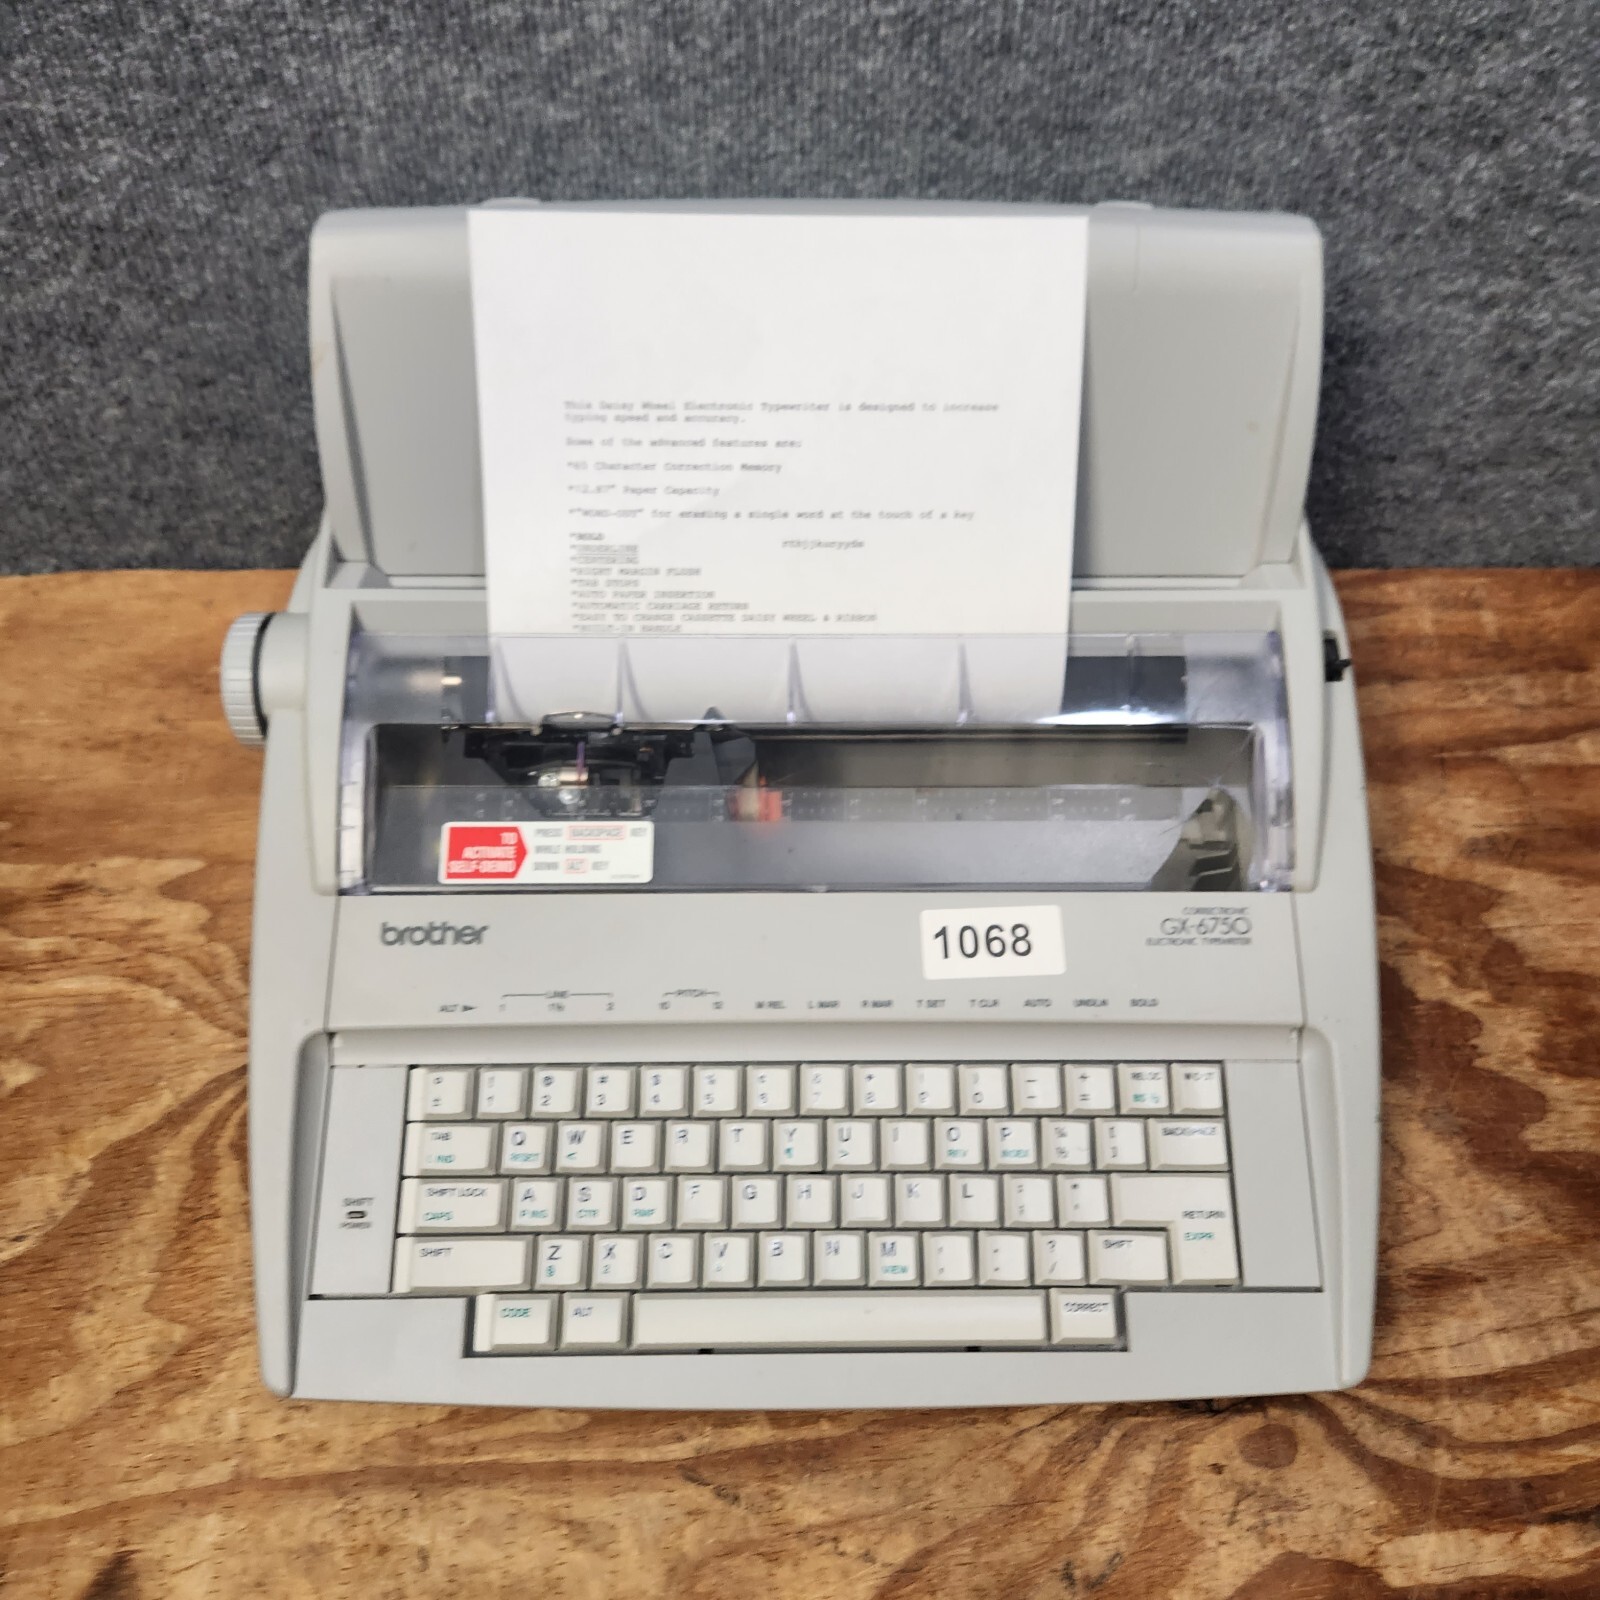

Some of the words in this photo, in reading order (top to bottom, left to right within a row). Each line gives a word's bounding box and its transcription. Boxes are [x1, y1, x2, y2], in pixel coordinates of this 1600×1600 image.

[642, 401, 675, 411] Wheel
[684, 401, 752, 411] Electronic
[760, 402, 829, 412] Typewriter
[858, 403, 915, 413] designed
[943, 403, 999, 413] increase
[614, 414, 648, 424] speed
[656, 414, 676, 424] and
[566, 437, 592, 447] Some
[622, 437, 641, 447] the
[650, 437, 705, 447] advanced
[712, 438, 767, 448] features
[594, 462, 656, 472] Character
[663, 462, 733, 472] Correction
[741, 463, 781, 473] Memory
[623, 486, 656, 495] Paper
[664, 487, 719, 496] Capacity
[651, 508, 671, 518] for
[748, 509, 789, 519] single
[796, 509, 823, 519] word
[830, 509, 843, 519] at
[851, 509, 870, 519] the
[878, 509, 912, 519] touch
[919, 509, 933, 519] of
[953, 509, 974, 519] key
[1159, 916, 1252, 935] GX-6750
[380, 921, 489, 946] brother
[932, 924, 1032, 959] 1068
[1023, 998, 1052, 1008] AUTO
[1130, 998, 1158, 1007] BOLD
[540, 1094, 552, 1106] 2
[597, 1093, 606, 1106] 3
[566, 1130, 587, 1145] W
[621, 1129, 635, 1145] E
[675, 1128, 689, 1145] R
[731, 1127, 744, 1142] T
[784, 1128, 798, 1143] Y
[838, 1126, 852, 1142] U
[946, 1126, 961, 1142] O
[999, 1126, 1013, 1142] P
[1162, 1126, 1217, 1136] BACKSPACE
[425, 1187, 457, 1198] SHIFT
[458, 1187, 488, 1198] LOCK
[521, 1187, 536, 1202] A
[577, 1186, 592, 1202] S
[632, 1185, 647, 1201] D
[688, 1184, 702, 1200] F
[742, 1184, 758, 1200] G
[797, 1183, 811, 1200] H
[851, 1183, 865, 1199] J
[906, 1183, 920, 1199] K
[960, 1183, 974, 1199] L
[1181, 1210, 1226, 1219] RETURN
[602, 1244, 617, 1259] X
[658, 1242, 672, 1259] C
[714, 1242, 728, 1258] V
[771, 1241, 784, 1257] B
[825, 1241, 840, 1256] N
[880, 1240, 897, 1257] M
[1102, 1239, 1134, 1249] SHIFT
[419, 1247, 453, 1257] SHIFT
[547, 1244, 562, 1260] Z
[500, 1307, 531, 1318] CODE
[572, 1306, 593, 1317] ALT
[1064, 1302, 1110, 1312] CORRECT
